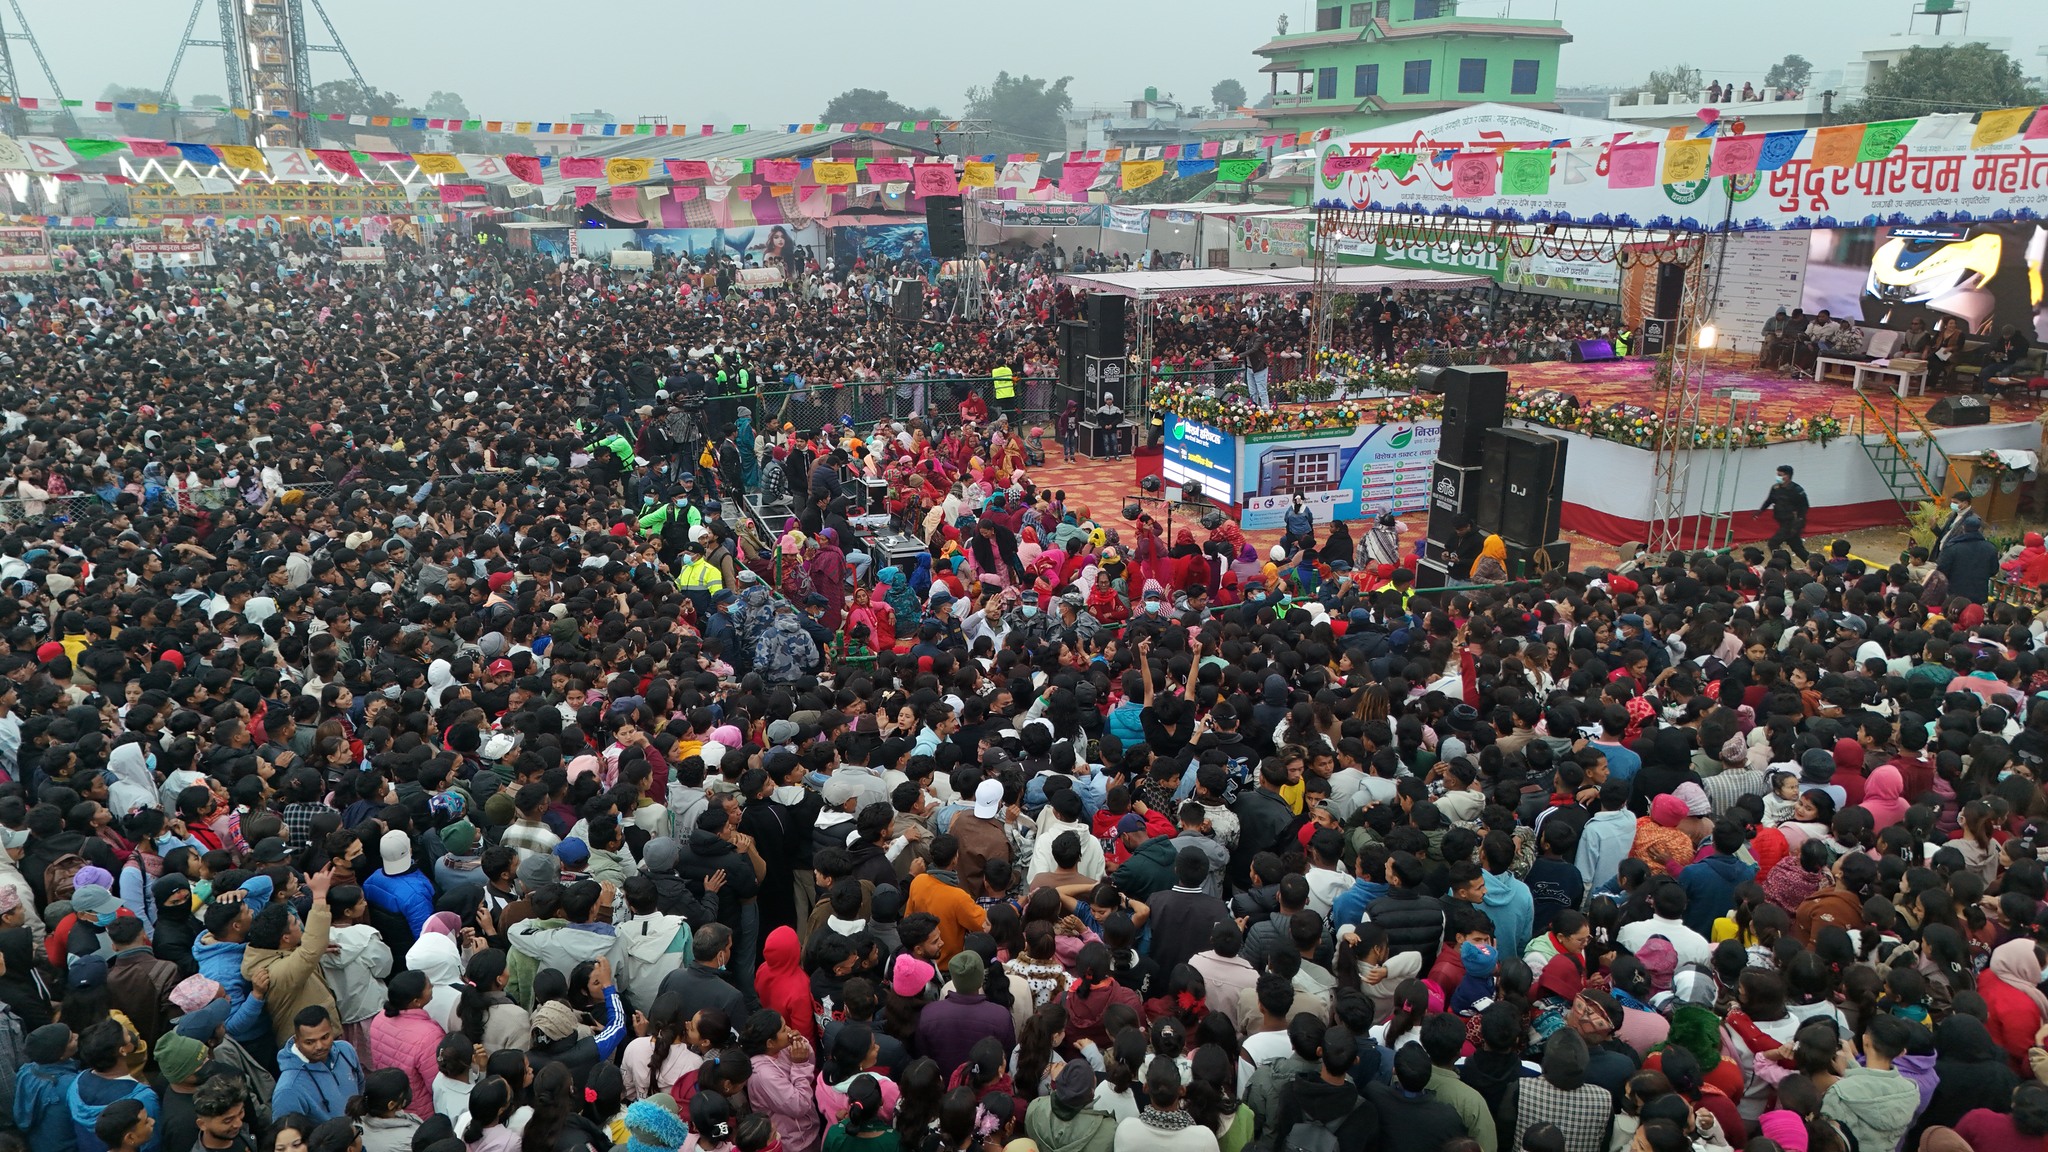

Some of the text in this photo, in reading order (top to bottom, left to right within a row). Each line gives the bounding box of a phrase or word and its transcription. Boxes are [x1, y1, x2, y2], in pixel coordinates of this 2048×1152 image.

[1893, 229, 1938, 237] XOOM
[569, 230, 578, 255] TICKET
[1510, 483, 1527, 497] D.J
